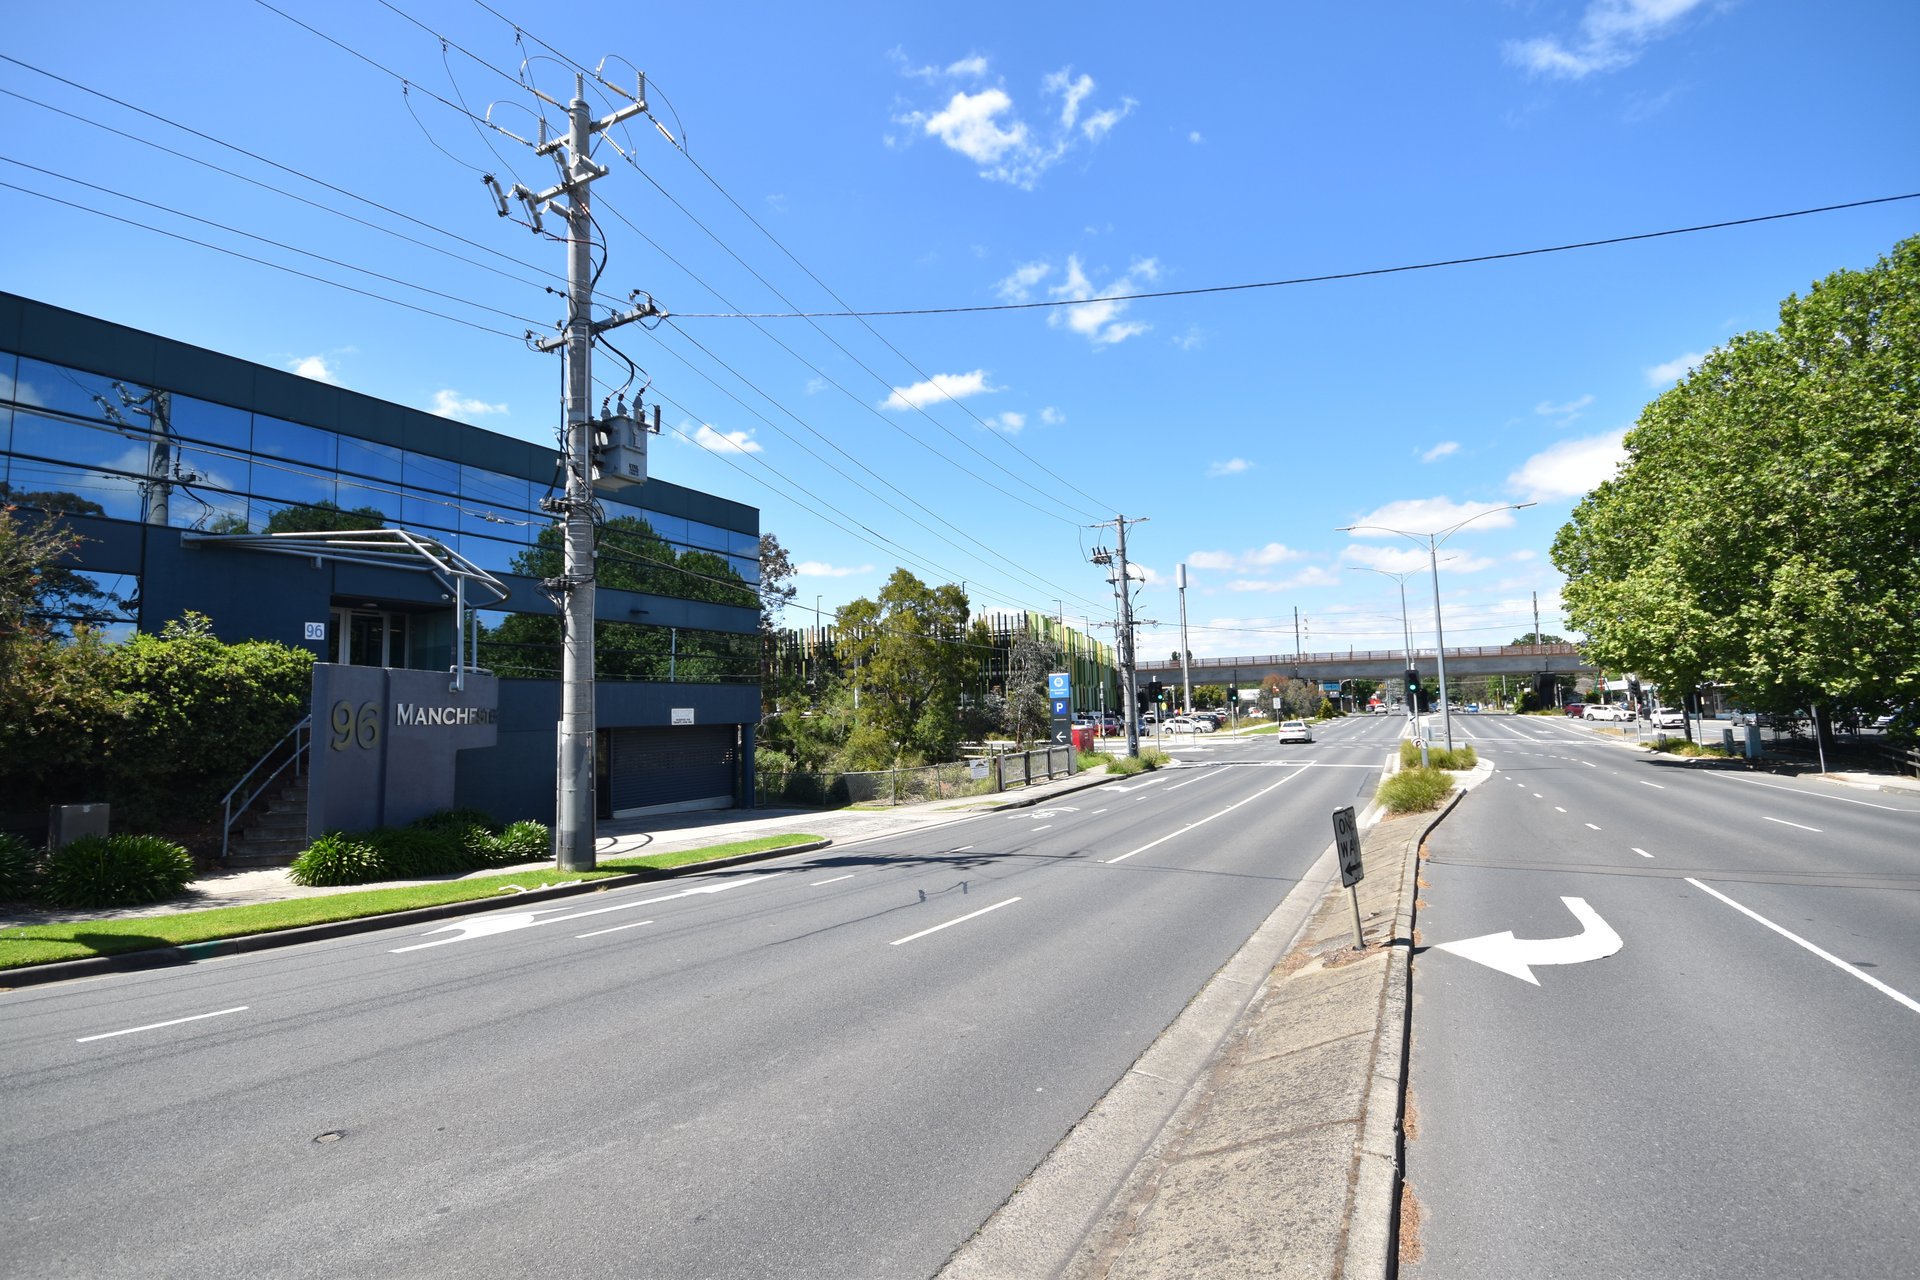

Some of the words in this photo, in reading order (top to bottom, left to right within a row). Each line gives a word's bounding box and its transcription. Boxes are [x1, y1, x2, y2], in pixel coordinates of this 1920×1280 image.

[306, 623, 323, 638] 96
[1056, 702, 1064, 713] P
[331, 699, 380, 752] 96
